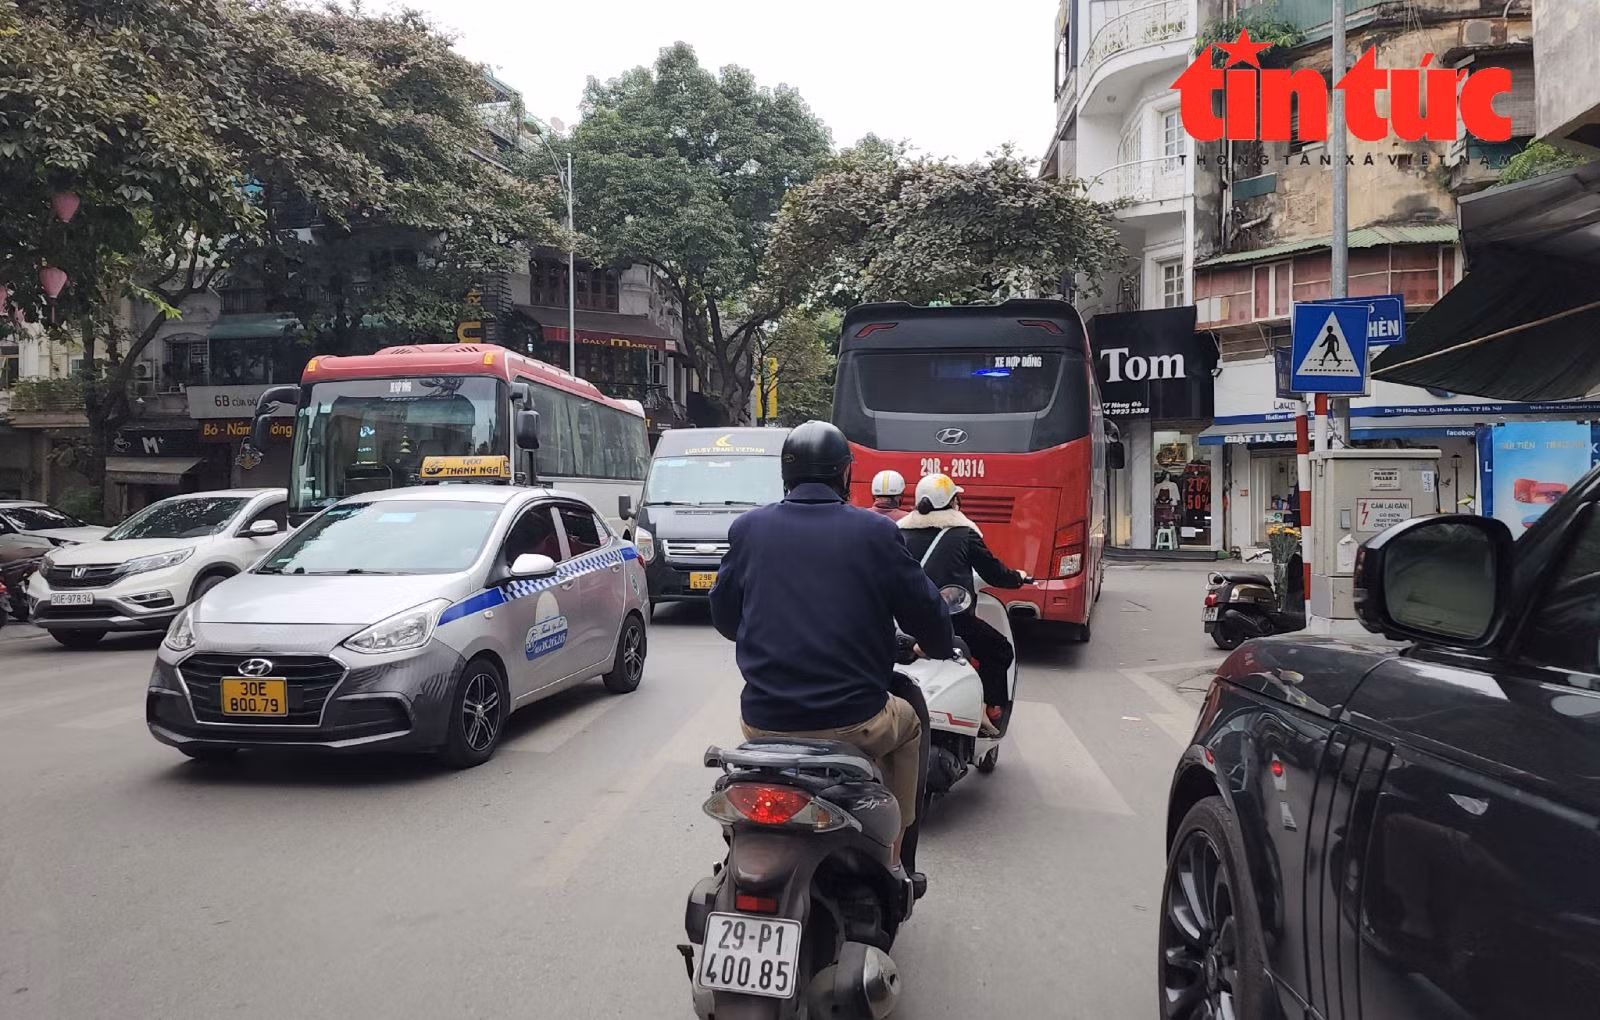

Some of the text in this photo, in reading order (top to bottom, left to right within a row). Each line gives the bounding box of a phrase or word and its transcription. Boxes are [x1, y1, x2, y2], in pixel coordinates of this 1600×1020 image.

[1369, 317, 1400, 338] HÈN
[995, 356, 1005, 368] XE
[1101, 347, 1187, 383] Tom
[214, 394, 230, 407] 6B
[446, 467, 477, 475] THANH
[479, 466, 499, 475] NGA
[951, 458, 985, 478] 20314
[240, 682, 268, 696] 30E
[230, 697, 279, 712] 800.79
[718, 919, 785, 956] 29-P1
[705, 952, 790, 992] 400.85
